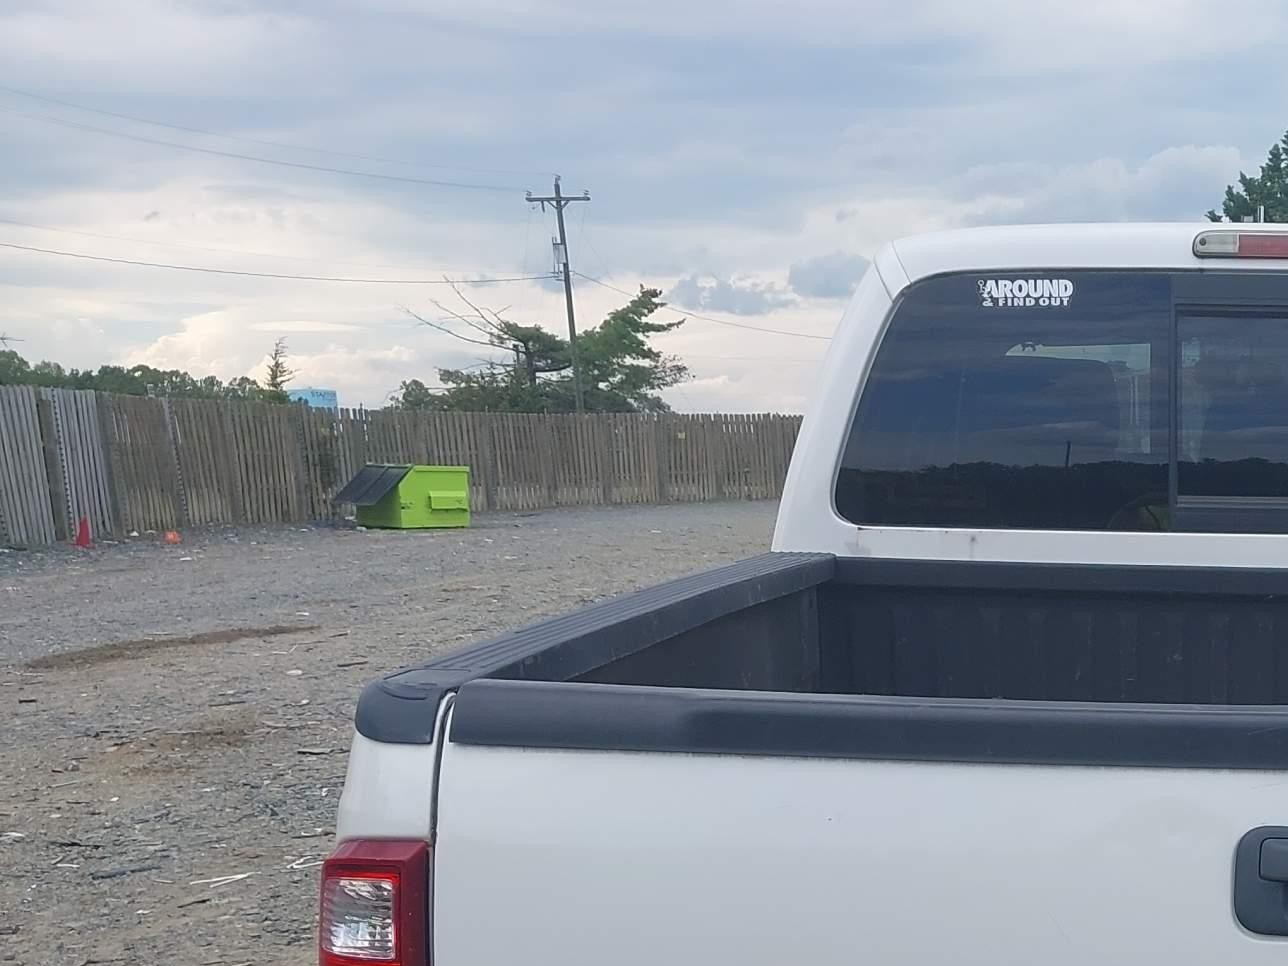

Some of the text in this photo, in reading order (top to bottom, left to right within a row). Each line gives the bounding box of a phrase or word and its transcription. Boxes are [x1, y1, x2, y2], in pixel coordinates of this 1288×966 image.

[985, 279, 1074, 298] AROUND
[982, 297, 1070, 307] & FIND OUT
